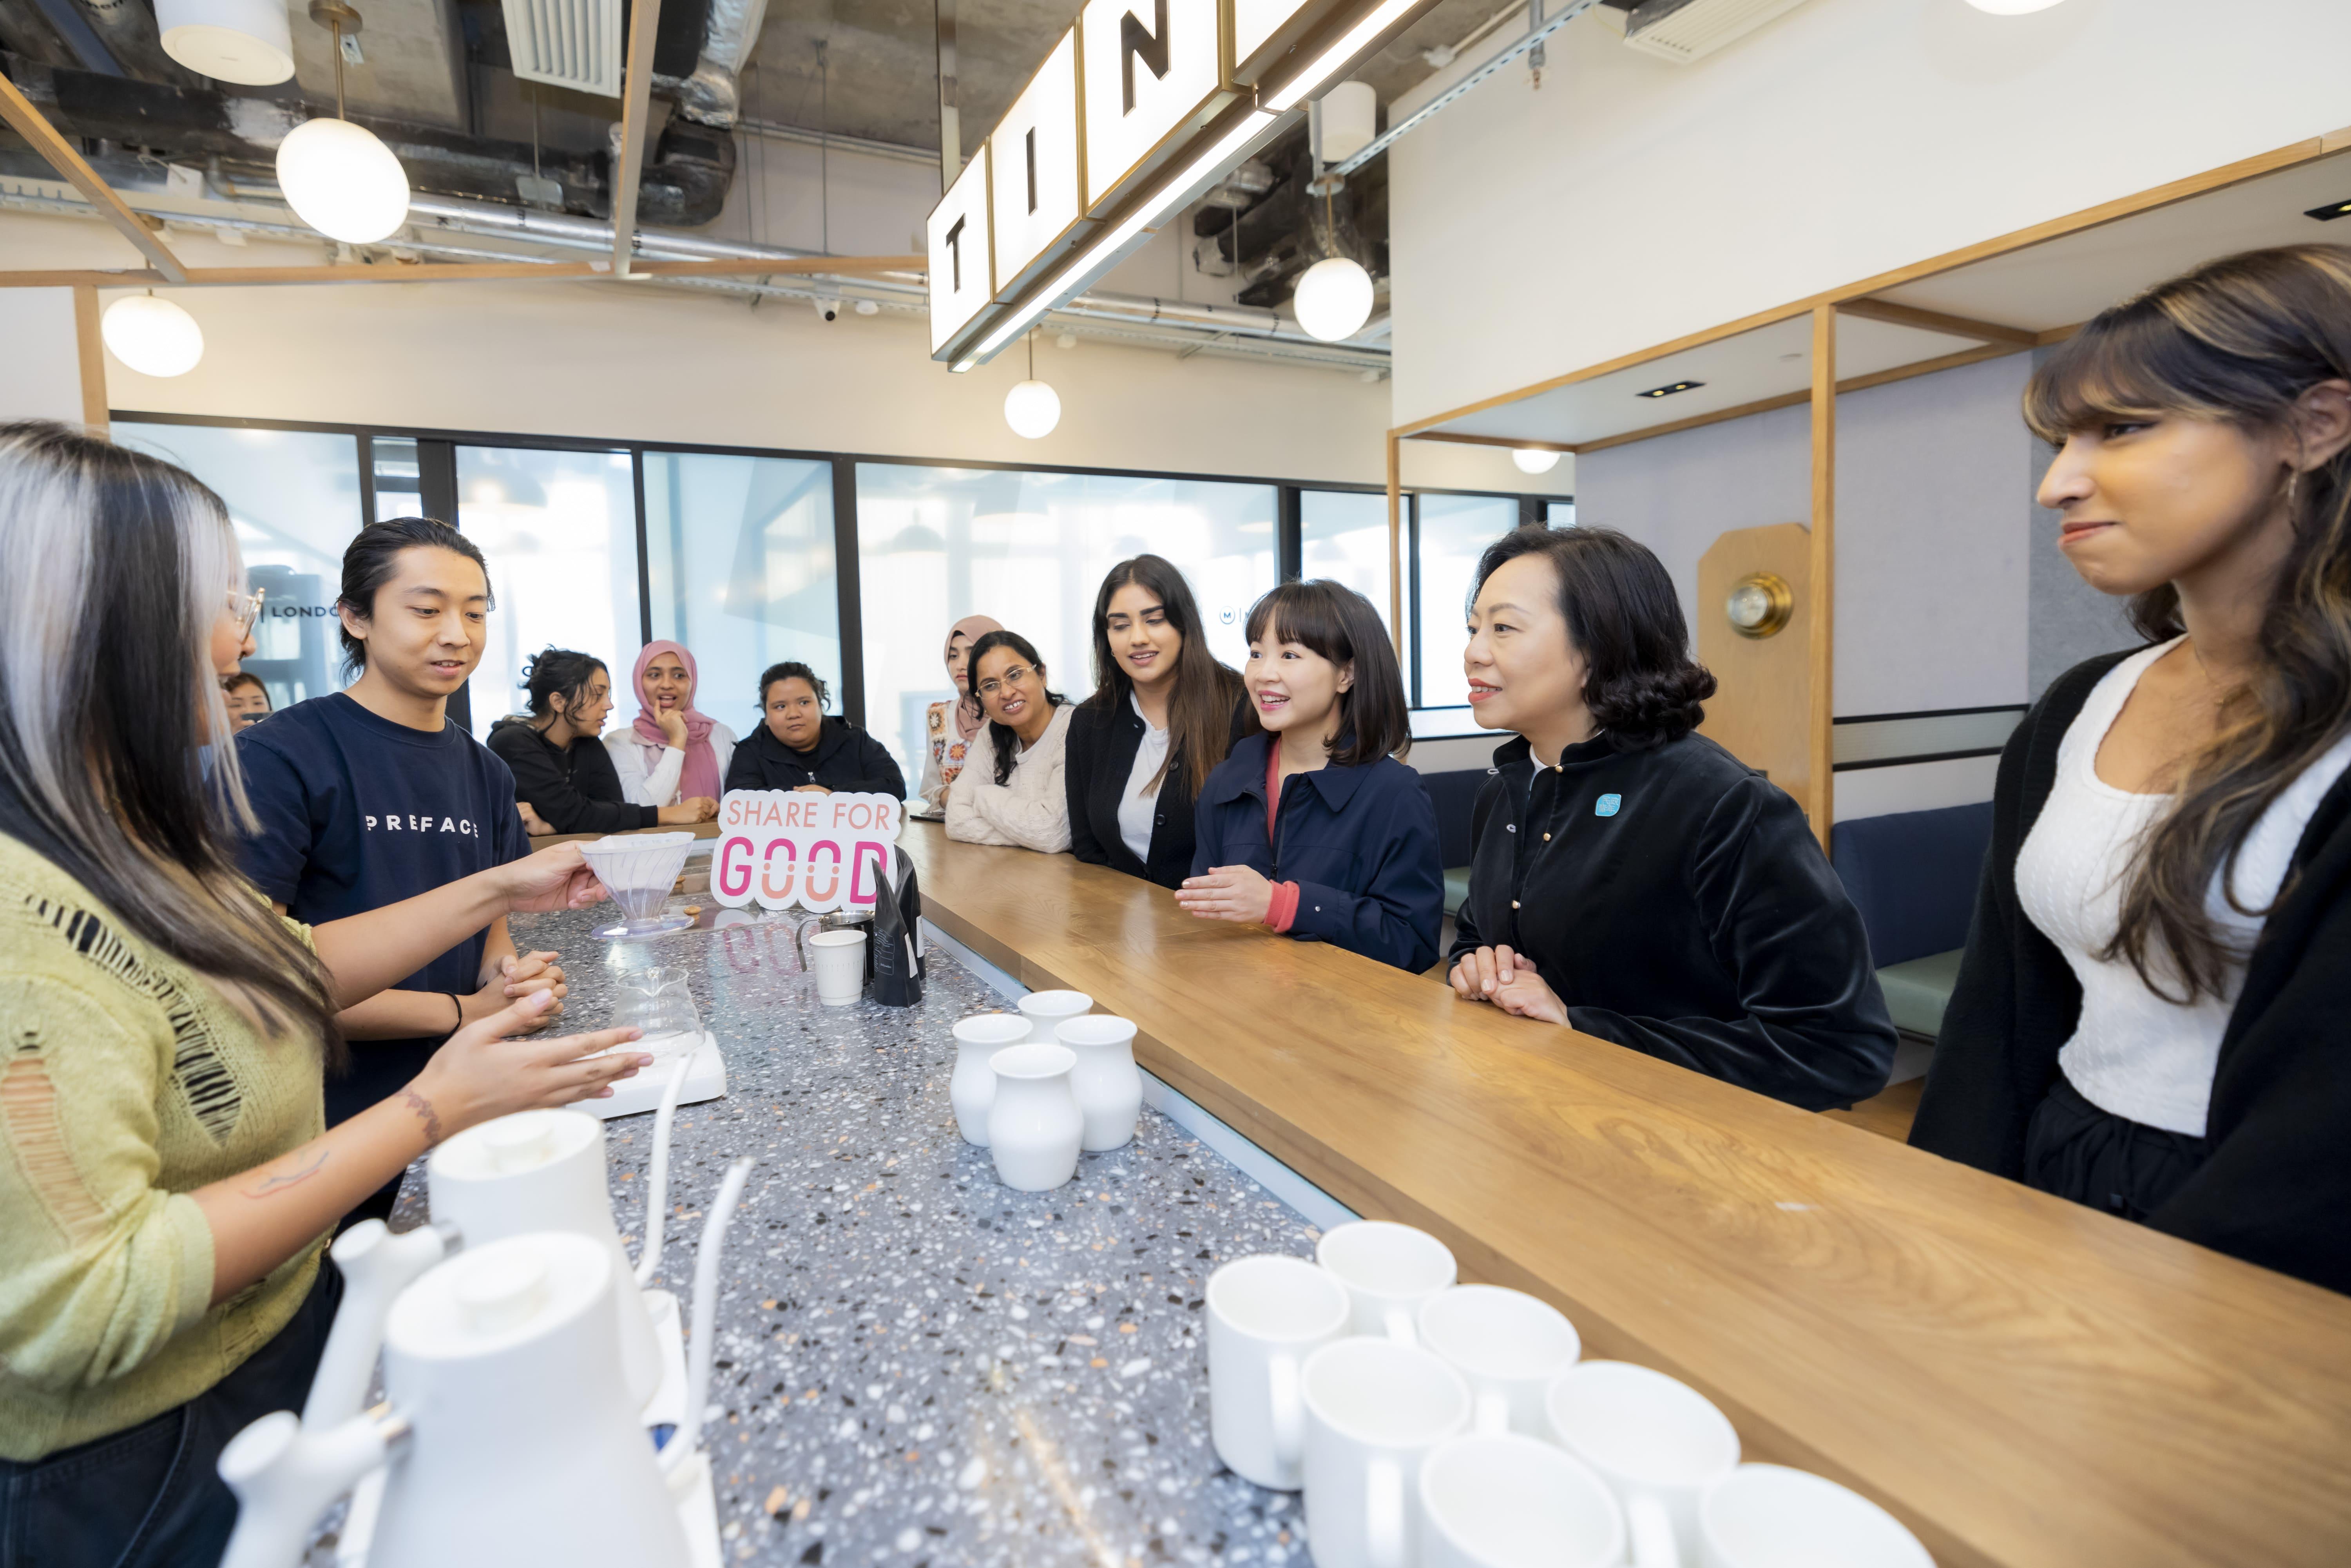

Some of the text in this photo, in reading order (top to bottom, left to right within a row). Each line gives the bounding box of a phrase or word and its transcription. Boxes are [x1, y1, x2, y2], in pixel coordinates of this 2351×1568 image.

[366, 815, 478, 838] PREFACE
[727, 800, 889, 830] SHARE FOR
[720, 837, 888, 904] GOOD
